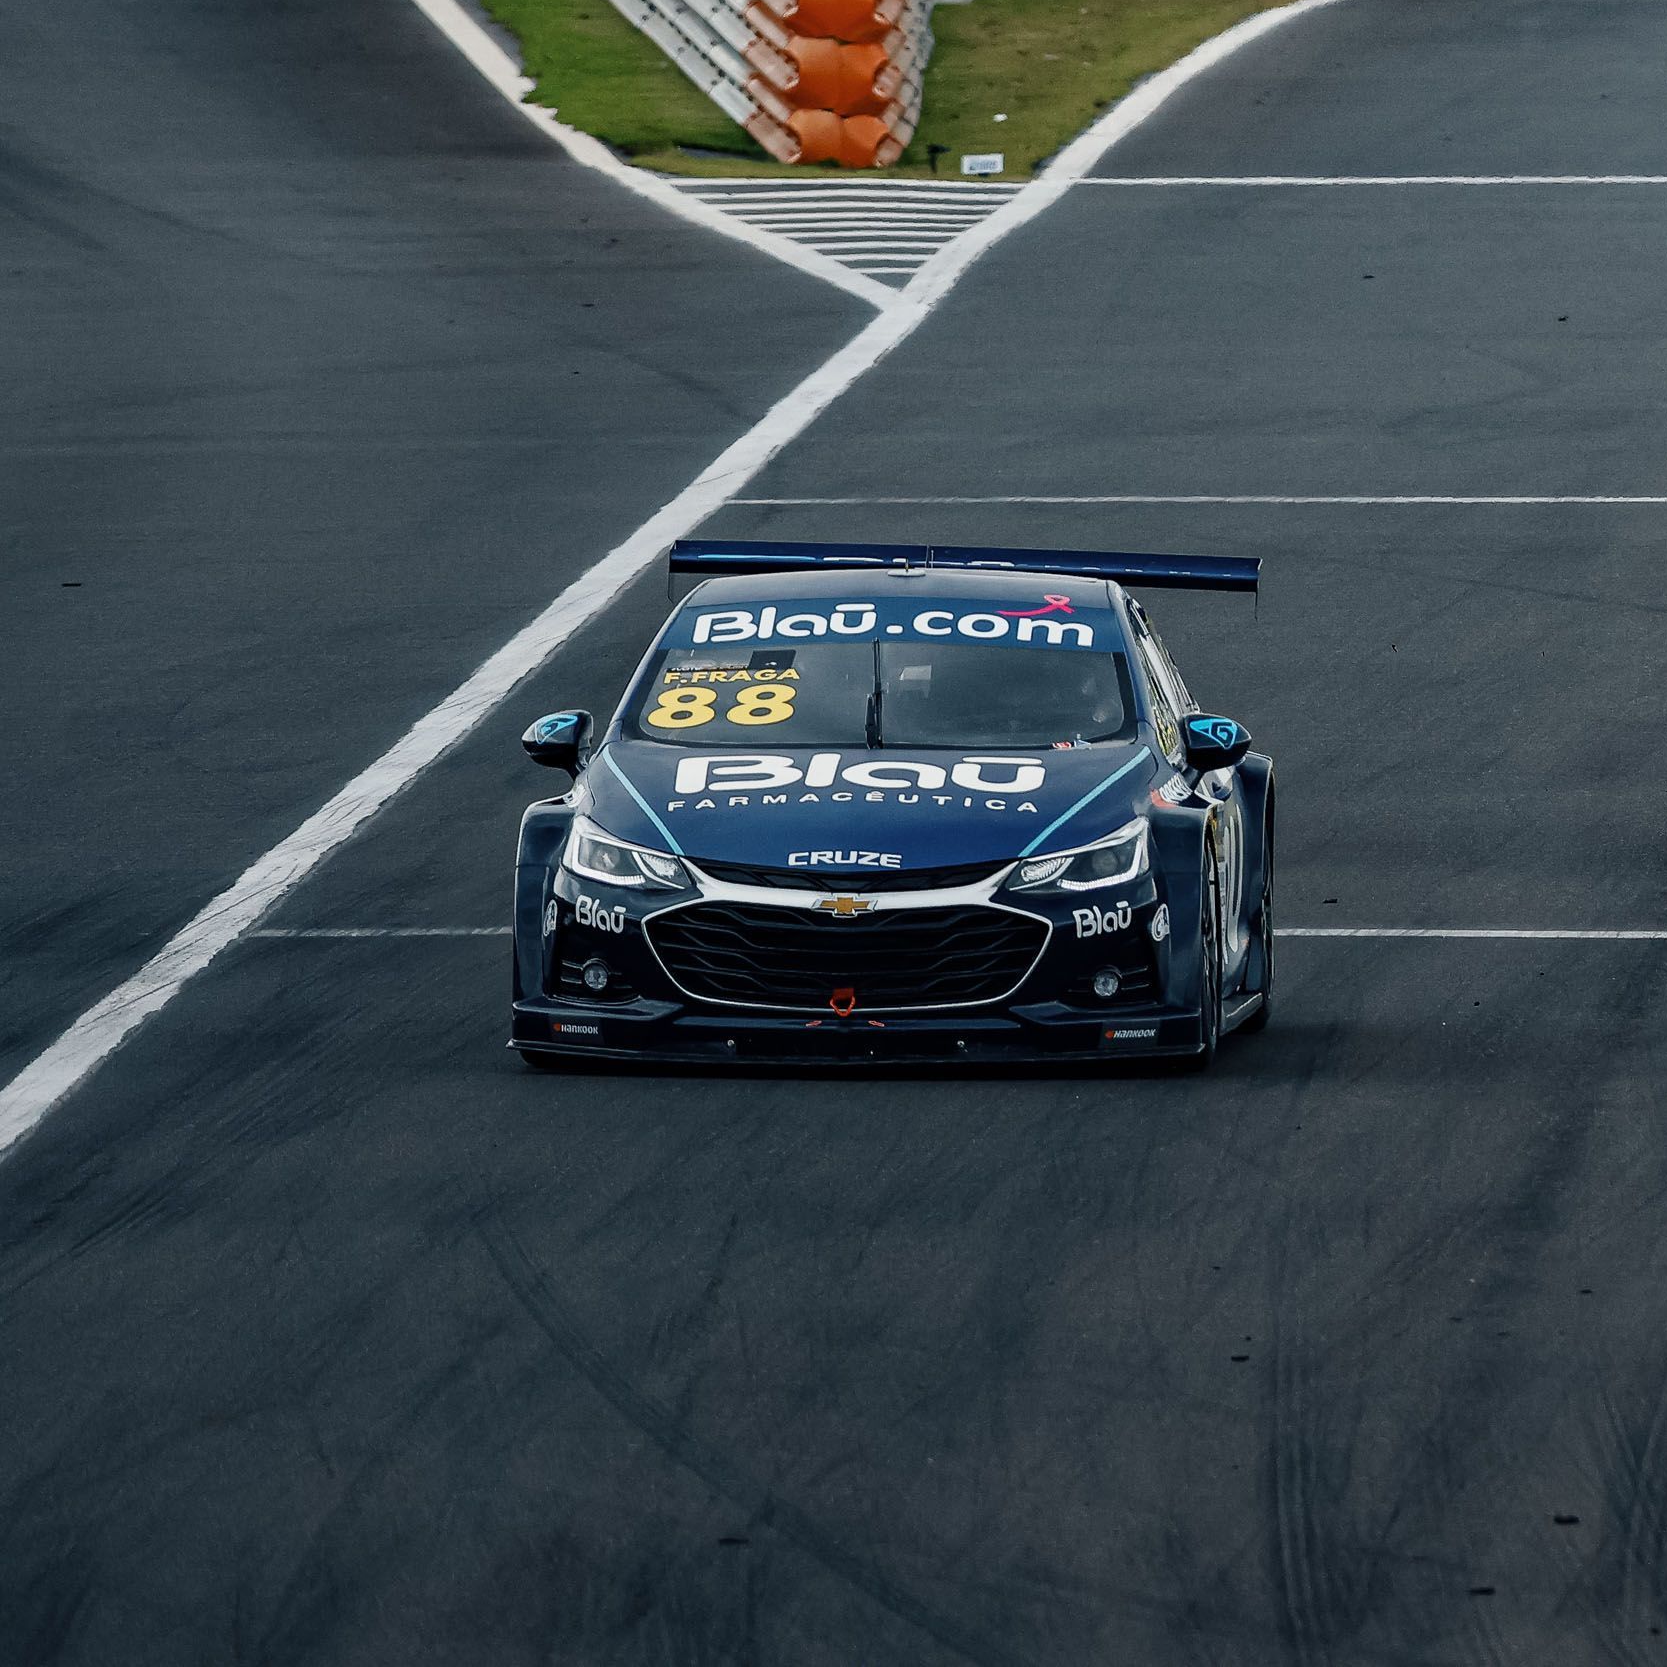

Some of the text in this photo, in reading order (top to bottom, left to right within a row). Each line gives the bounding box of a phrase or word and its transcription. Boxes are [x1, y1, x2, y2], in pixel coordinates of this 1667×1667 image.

[663, 668, 800, 684] F.FRAGA
[647, 683, 797, 728] 88
[667, 791, 1039, 813] FARMACÊUTICA
[788, 851, 903, 868] CRUZE
